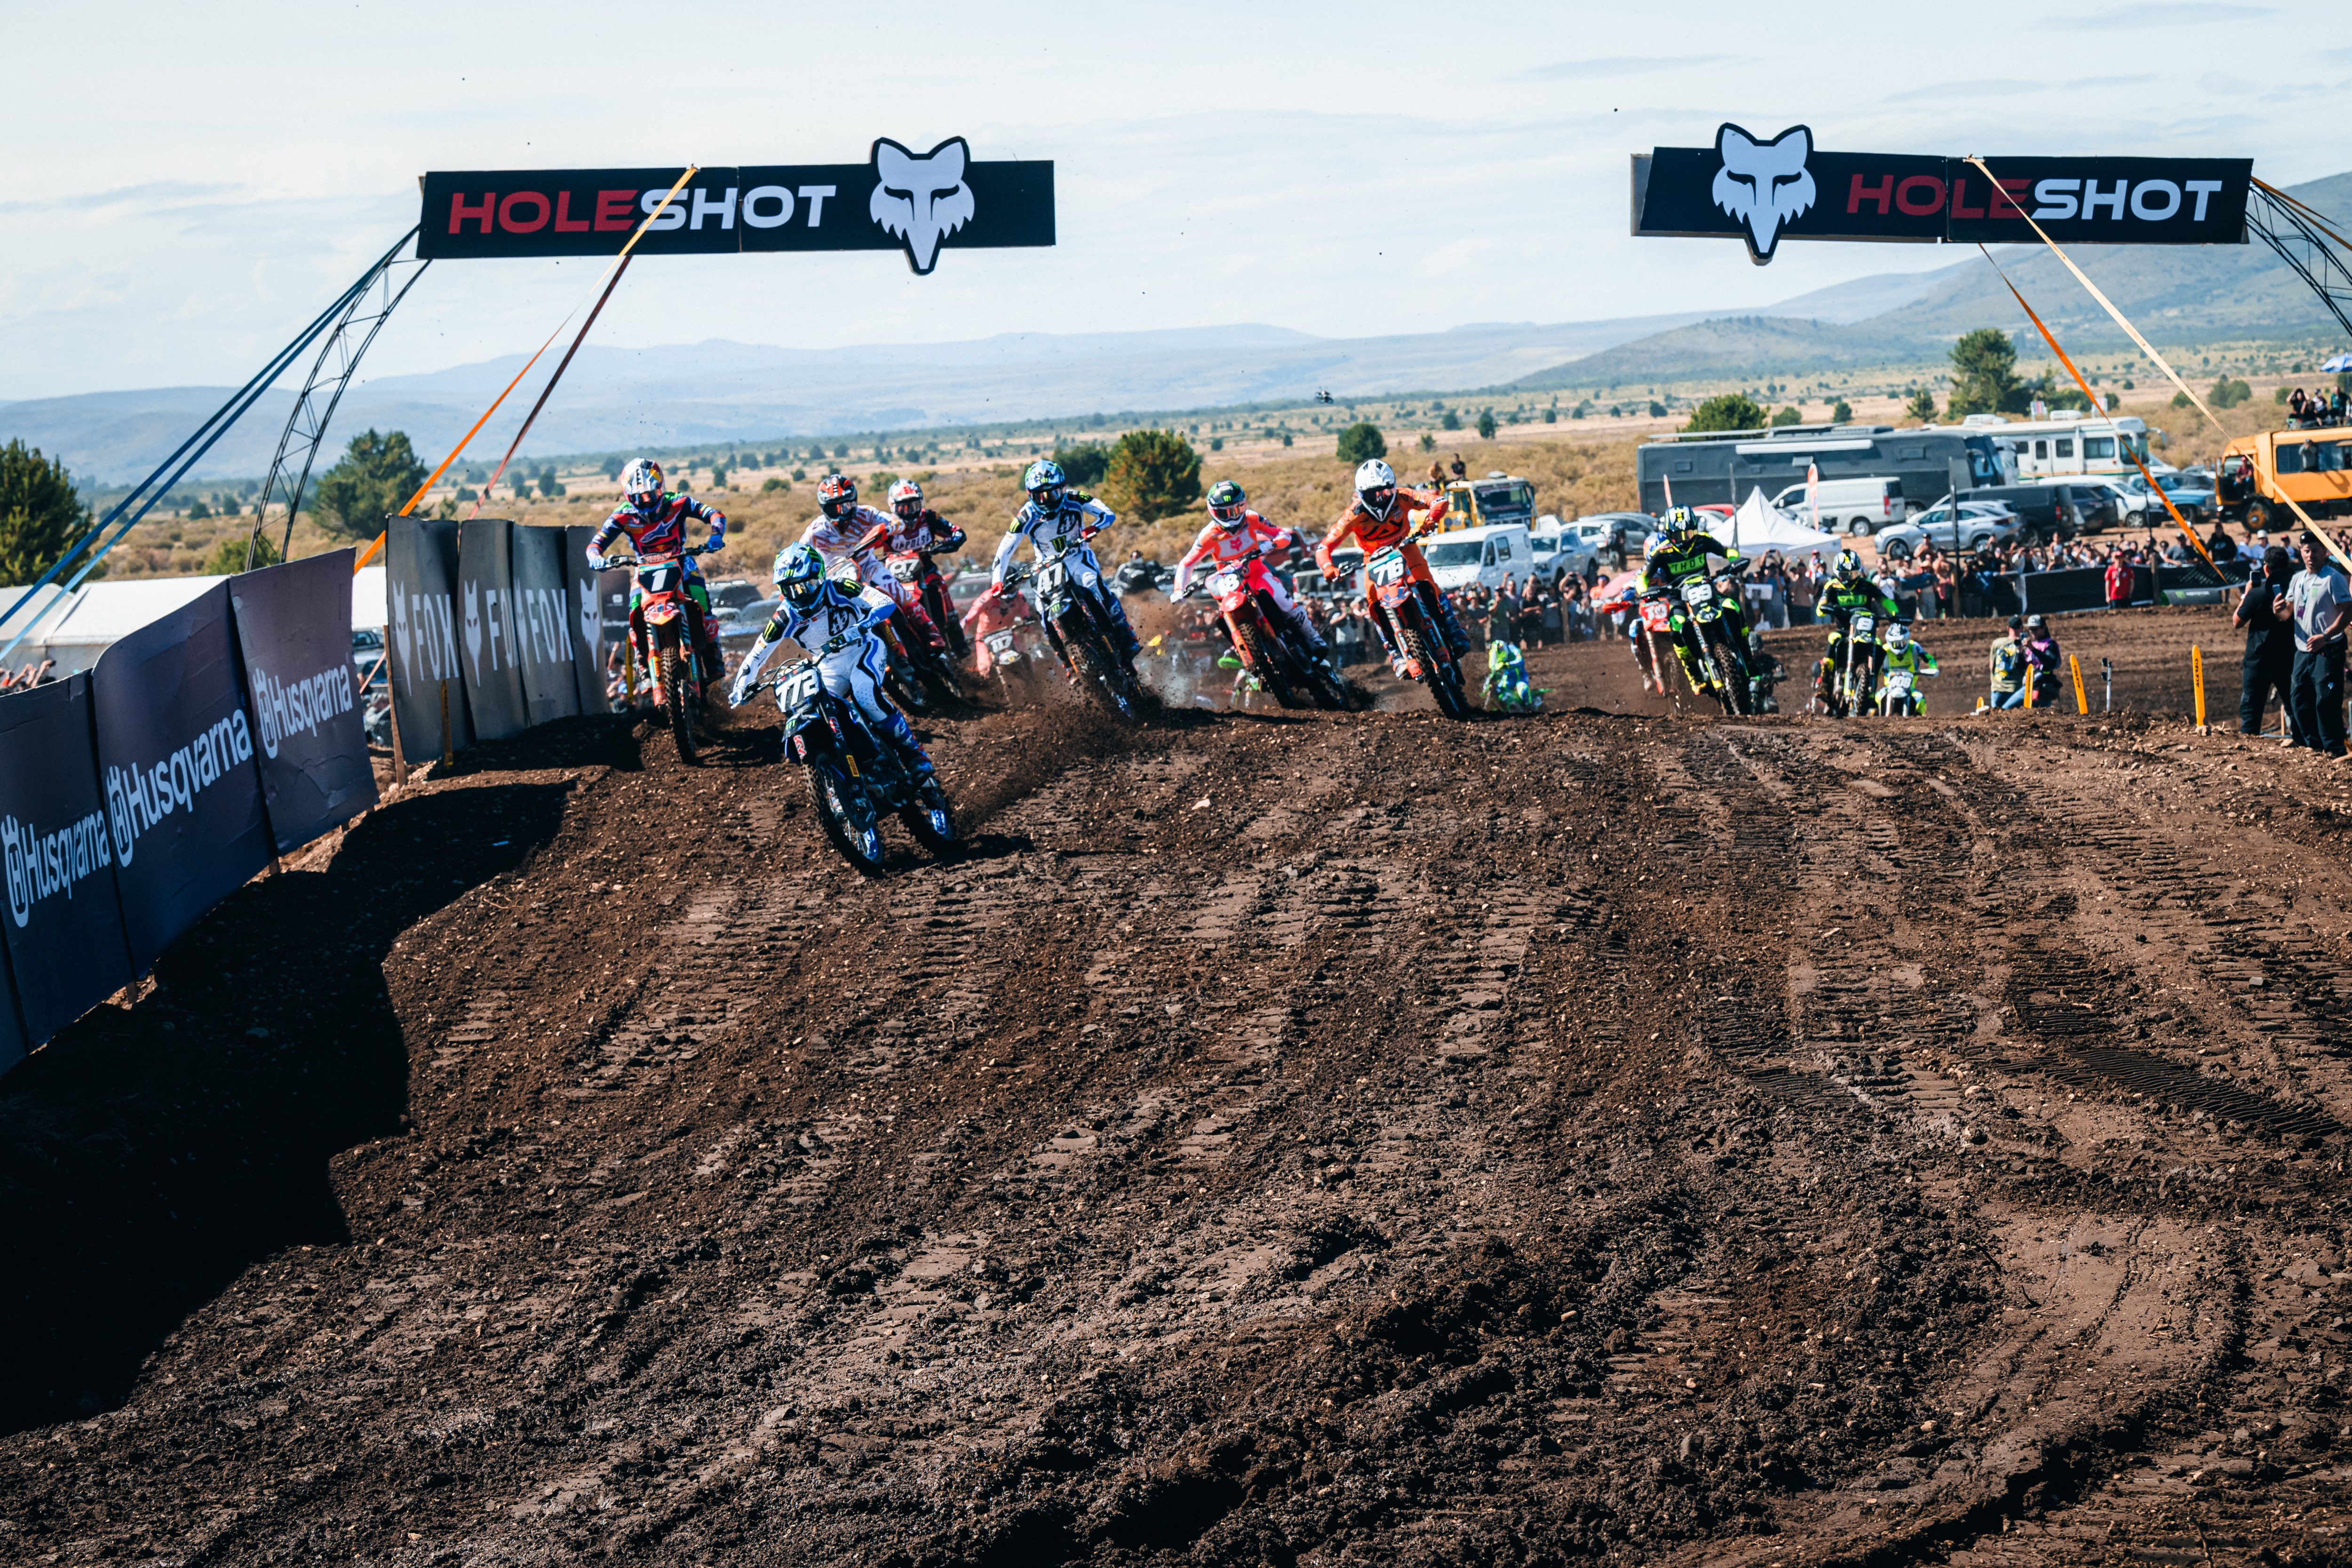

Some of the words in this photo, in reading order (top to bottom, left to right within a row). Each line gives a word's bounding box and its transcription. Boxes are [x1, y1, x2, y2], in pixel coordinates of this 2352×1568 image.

[448, 185, 836, 234] HOLESHOT
[1846, 174, 2223, 222] HOLESHOT
[652, 569, 667, 592] 1
[890, 559, 919, 578] 97
[1037, 562, 1063, 594] 47
[1373, 557, 1404, 586] 716
[525, 589, 573, 663] FOX
[1645, 604, 1667, 620] 19
[412, 594, 459, 680] FOX
[268, 664, 353, 740] Husqvarna
[775, 669, 819, 712] 772
[123, 709, 254, 839] Husqvarna
[21, 810, 111, 904] Husqvarna
